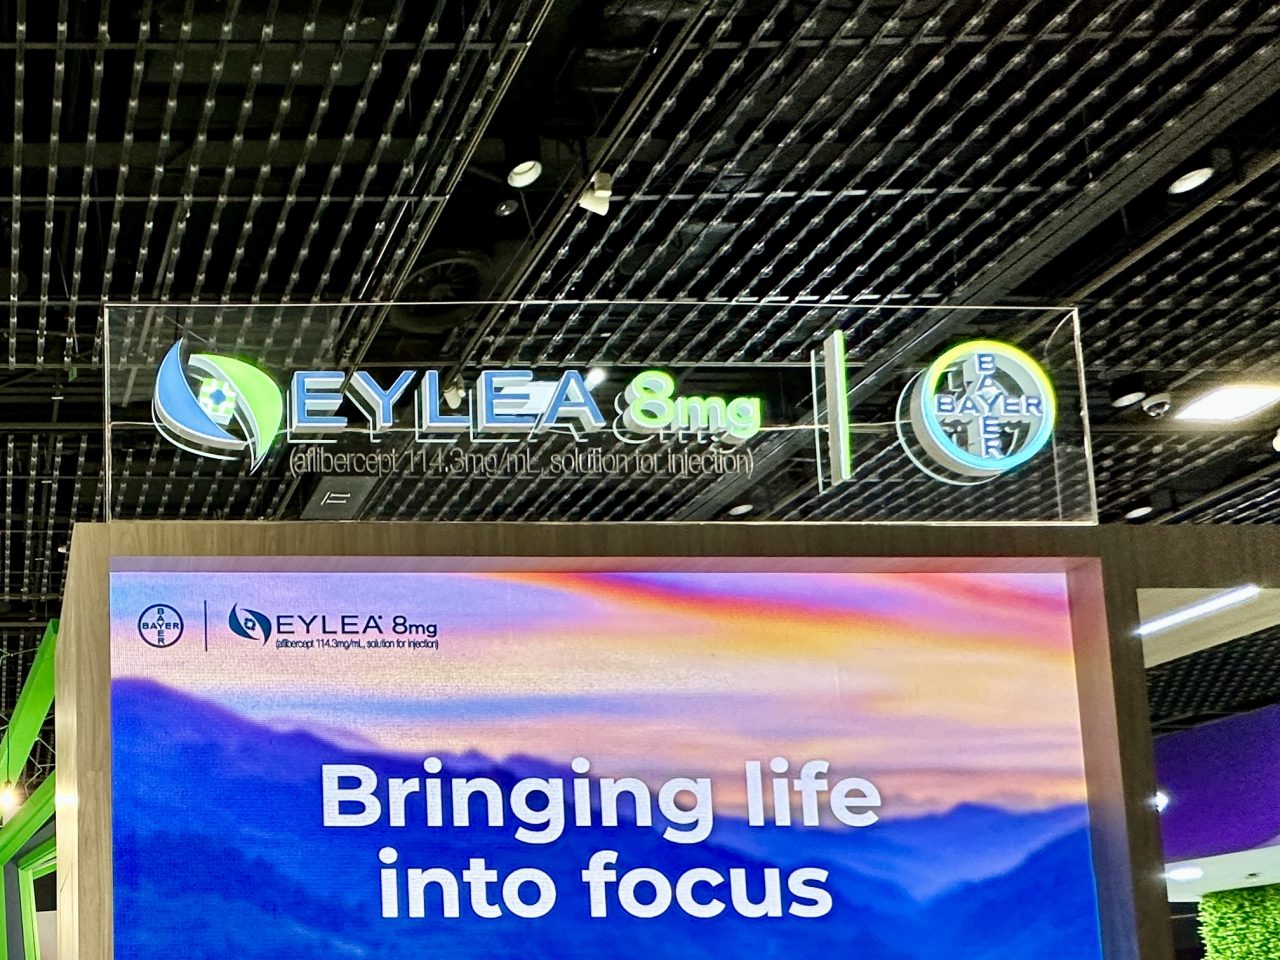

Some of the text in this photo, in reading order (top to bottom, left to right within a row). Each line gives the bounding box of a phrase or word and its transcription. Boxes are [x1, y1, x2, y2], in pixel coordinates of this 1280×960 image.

[292, 370, 761, 444] EYLEA 8mg
[934, 393, 1043, 415] BAYER
[975, 353, 1007, 458] BAYER
[289, 447, 397, 477] (aflibercept
[550, 446, 629, 474] solution
[635, 448, 661, 474] for
[667, 447, 754, 479] injection)
[142, 622, 180, 630] BAYER
[392, 615, 437, 637] 8mg
[367, 638, 395, 648] solution
[396, 638, 406, 648] for
[407, 638, 438, 649] injection)
[322, 757, 881, 844] Bringing life
[379, 847, 833, 918] into focus
